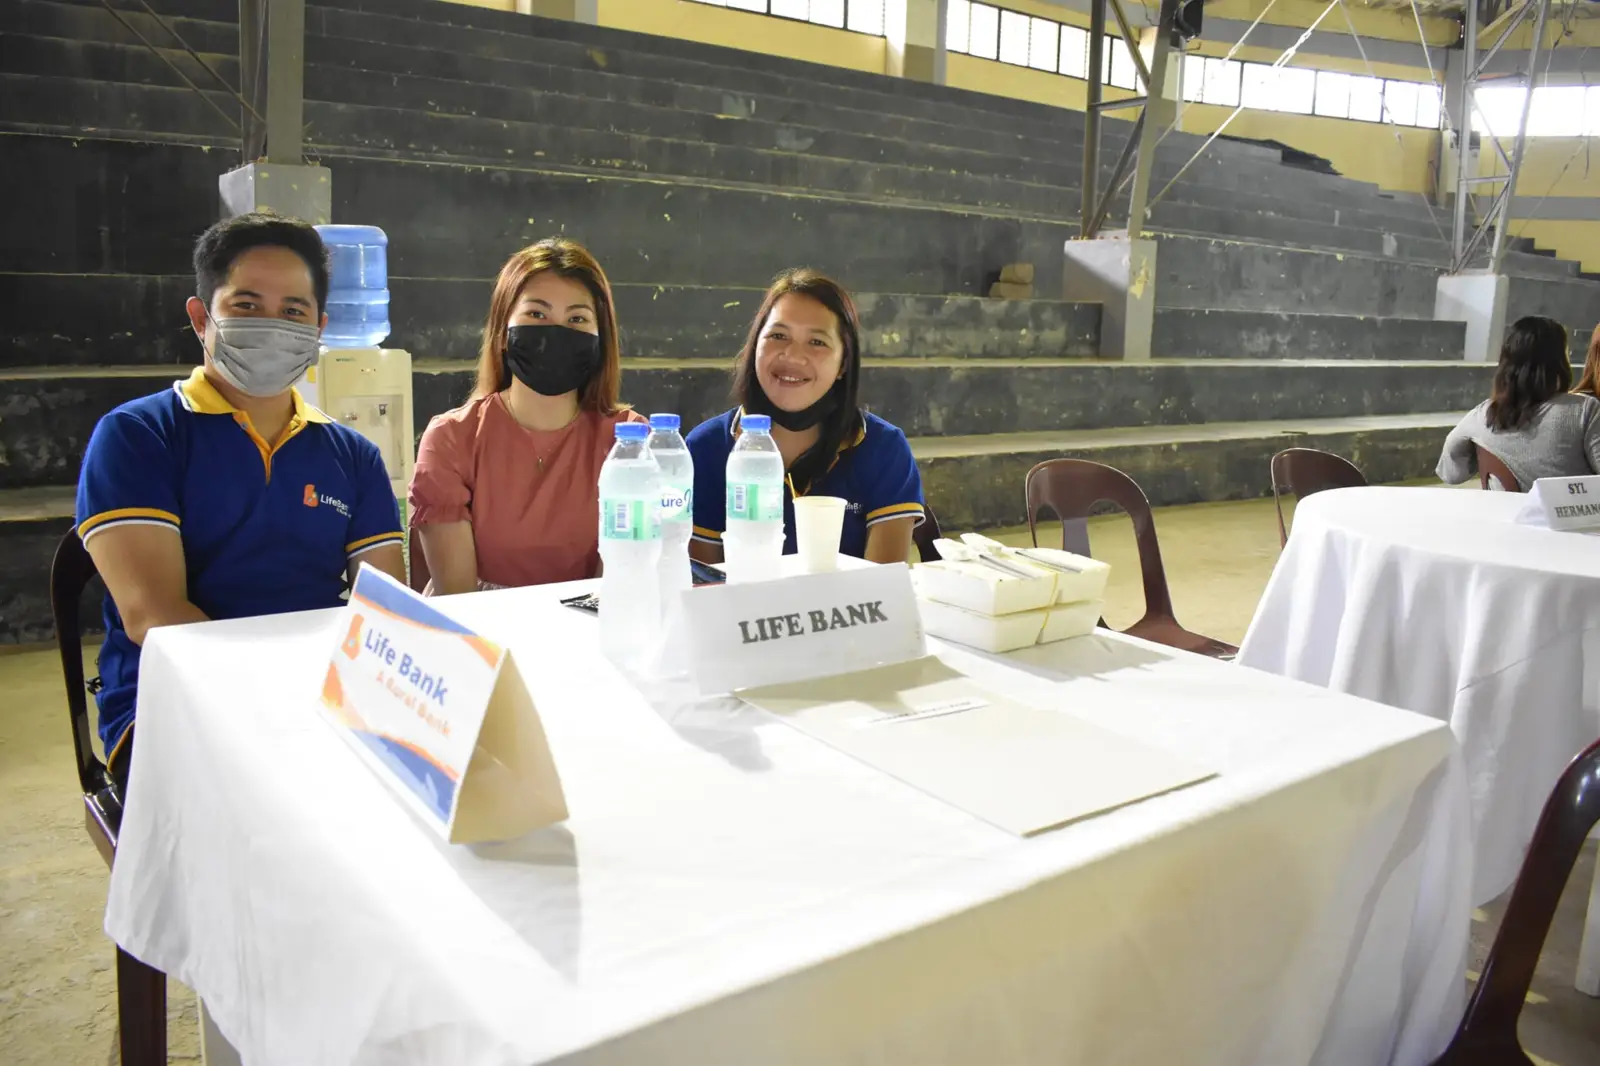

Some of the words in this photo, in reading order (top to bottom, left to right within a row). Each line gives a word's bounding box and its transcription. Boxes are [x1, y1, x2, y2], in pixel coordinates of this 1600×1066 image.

[738, 612, 805, 644] LIFE
[807, 600, 888, 633] BANK
[364, 628, 397, 666] Life
[398, 652, 449, 706] Bank
